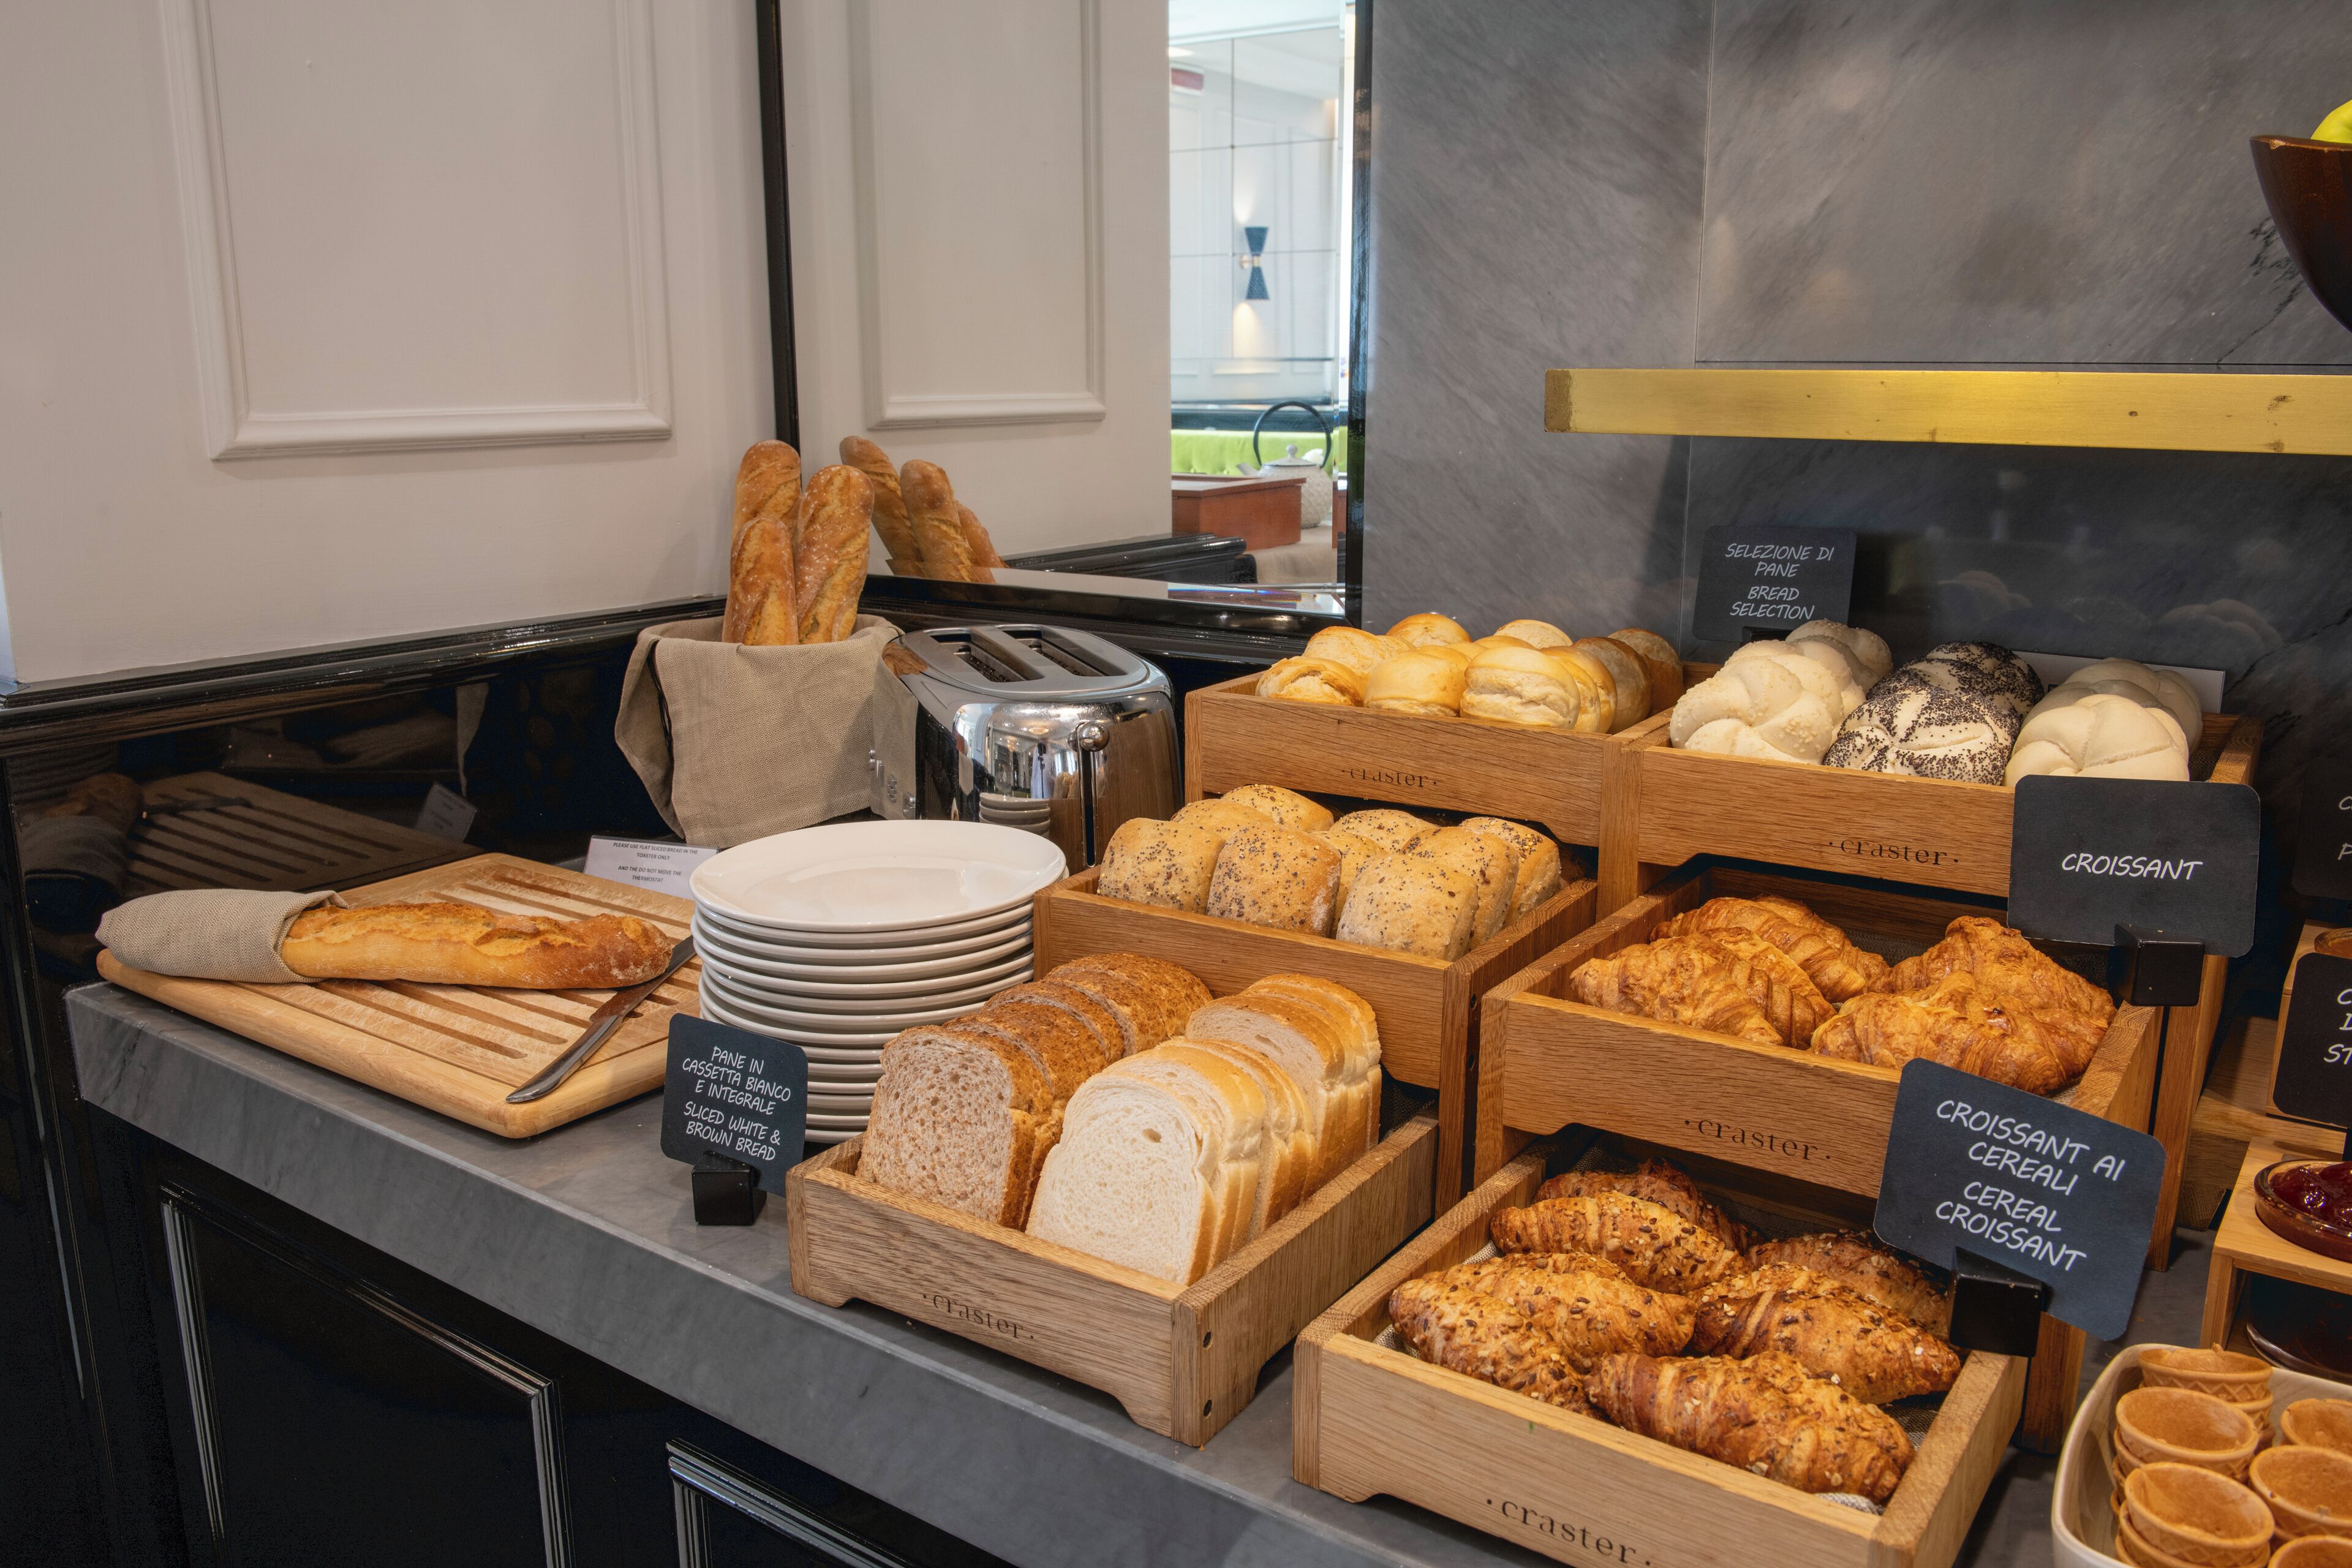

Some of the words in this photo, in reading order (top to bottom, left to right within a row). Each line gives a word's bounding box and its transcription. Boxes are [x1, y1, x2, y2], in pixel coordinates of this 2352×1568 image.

[1725, 543, 1813, 560] SELEZIONE
[1816, 547, 1834, 560] DI
[1755, 561, 1800, 578] PANE
[1730, 601, 1814, 620] SELECTION
[1747, 586, 1799, 601] BREAD
[2062, 853, 2203, 880] CROISSANT
[712, 1046, 746, 1068] PANE
[750, 1058, 764, 1074] IN
[682, 1058, 741, 1086] CASSETTA
[745, 1077, 791, 1101] BIANCO
[696, 1080, 706, 1093] E
[708, 1082, 776, 1115] INTEGRALE
[684, 1101, 724, 1124] SLICED
[729, 1115, 768, 1139] WHITE
[771, 1130, 781, 1145] &
[686, 1121, 733, 1147] BROWN
[736, 1137, 775, 1160] BREAD
[1937, 1100, 2089, 1164] CROISSANT
[2093, 1156, 2125, 1181] AI
[1969, 1142, 2078, 1196] CEREALI
[1964, 1182, 2062, 1232] CEREAL
[1936, 1201, 2086, 1270] CROISSANT
